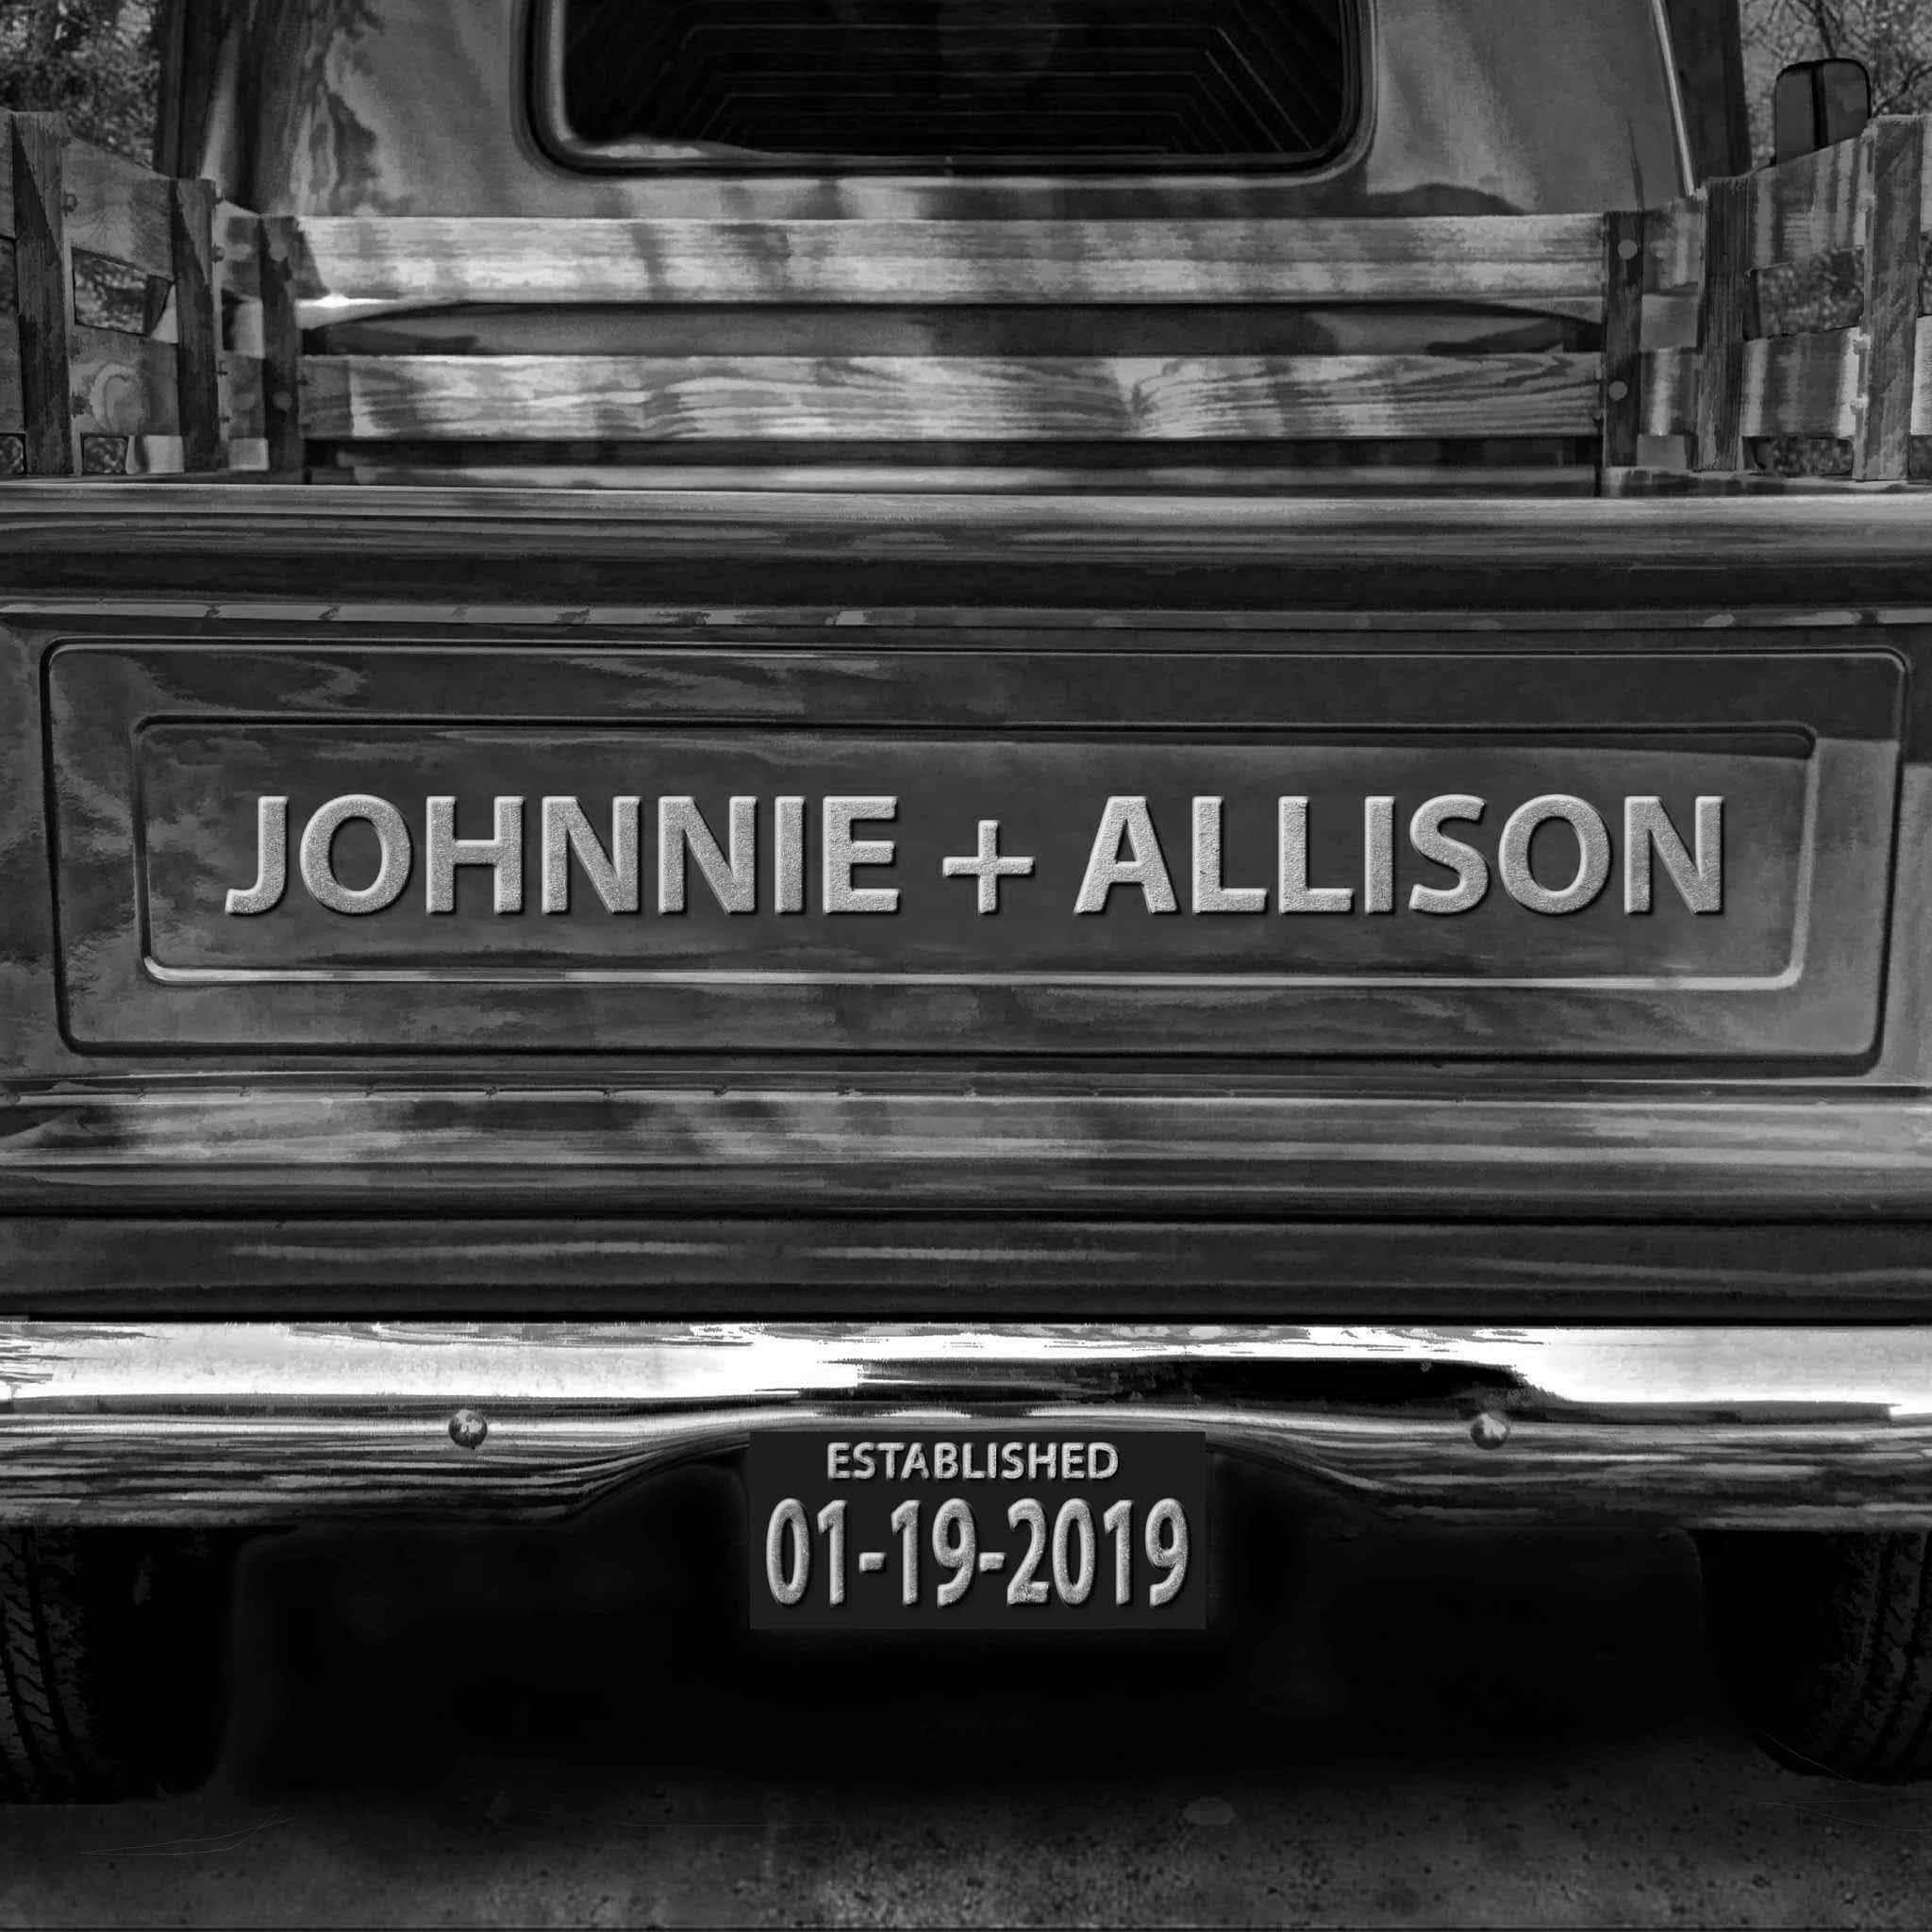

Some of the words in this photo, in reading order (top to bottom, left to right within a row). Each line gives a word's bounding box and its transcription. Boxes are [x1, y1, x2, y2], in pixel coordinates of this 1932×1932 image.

[225, 793, 899, 915] JOHNNIE
[1073, 793, 1724, 915] ALLISON
[826, 1441, 1119, 1479] ESTABLISHED
[765, 1497, 1189, 1607] 01-19-2019
